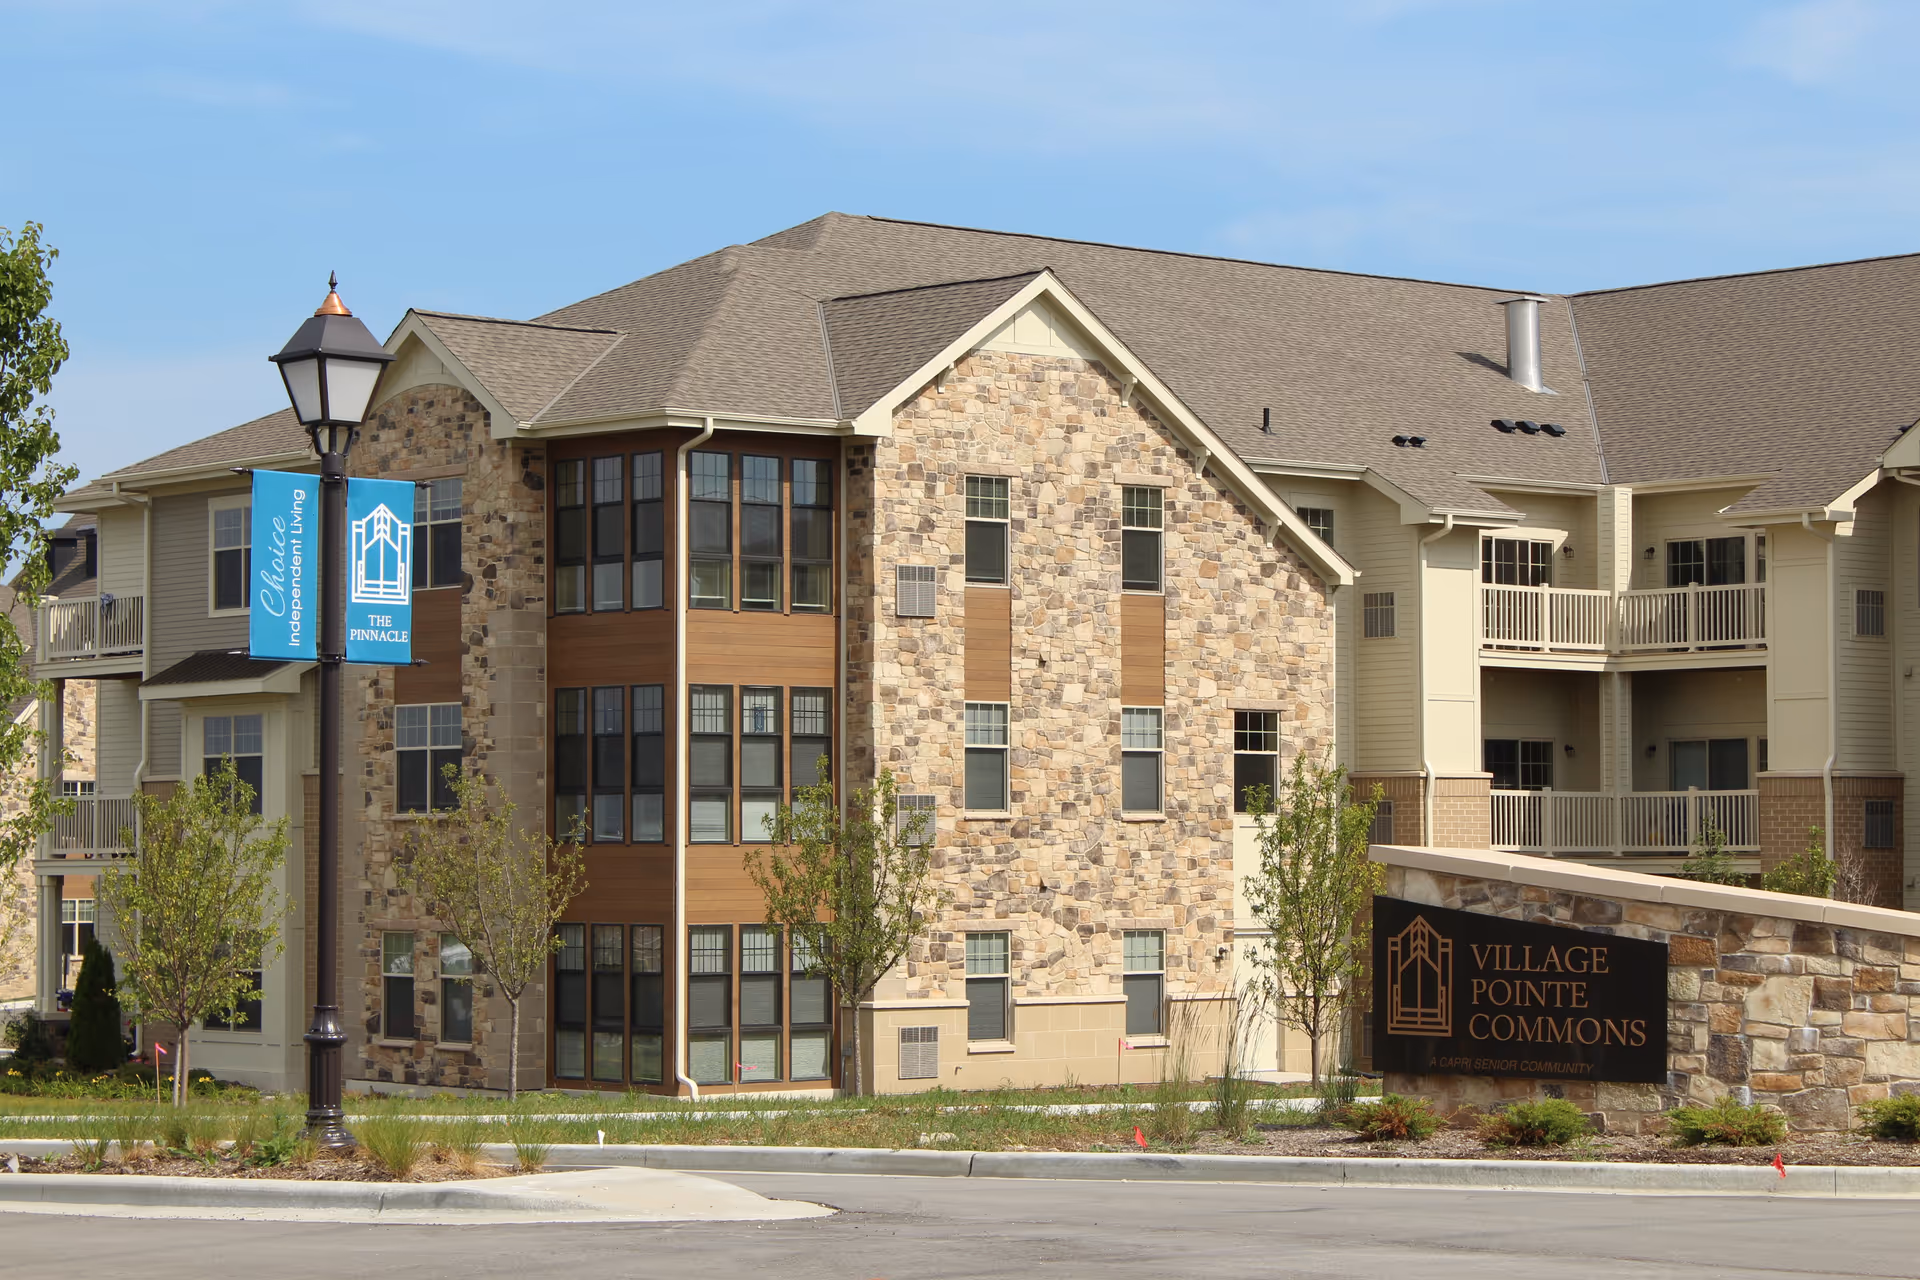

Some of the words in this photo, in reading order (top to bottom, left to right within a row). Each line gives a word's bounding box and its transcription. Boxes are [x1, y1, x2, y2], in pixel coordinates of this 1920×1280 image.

[290, 489, 306, 534] Living
[260, 515, 285, 617] Choice
[289, 538, 303, 646] Independent
[350, 629, 408, 643] PINNACLE
[368, 615, 392, 627] THE
[1470, 943, 1609, 974] VILLAGE
[1471, 978, 1589, 1009] POINTE
[1468, 1013, 1646, 1047] COMMONS
[1429, 1056, 1437, 1068] A
[1439, 1056, 1472, 1069] CAPRI
[1473, 1058, 1517, 1071] SENIOR
[1520, 1060, 1594, 1074] COMMUNITY
